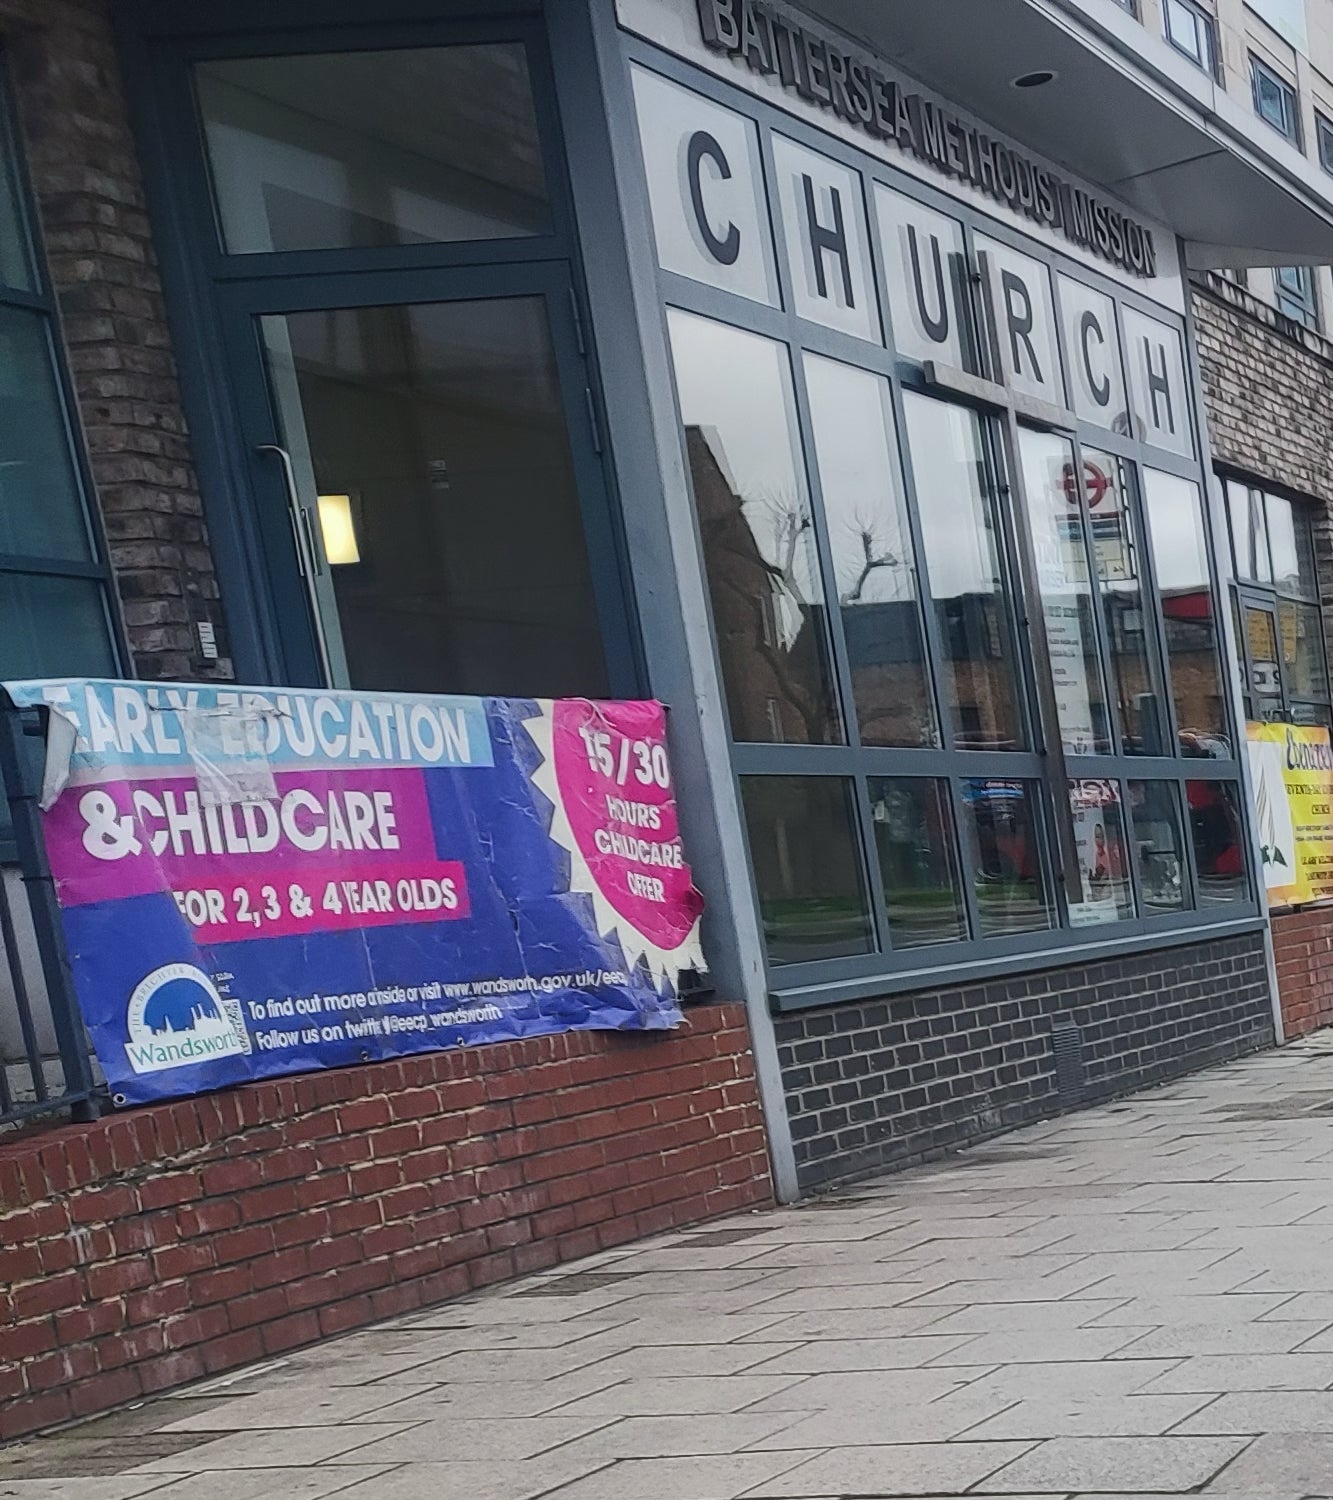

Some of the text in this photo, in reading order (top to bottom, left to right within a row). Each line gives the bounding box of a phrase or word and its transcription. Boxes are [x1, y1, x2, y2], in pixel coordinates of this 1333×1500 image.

[704, 0, 1157, 278] BATTERSEA METHODIST MISSION
[686, 131, 1175, 435] CHURCH
[216, 691, 472, 764] EDUCATION
[605, 793, 661, 831] HOURS
[594, 828, 684, 870] CHILDCARE
[172, 888, 228, 927] FOR
[289, 883, 313, 918] &
[396, 877, 459, 912] OLDS
[626, 870, 666, 903] OFFER
[248, 1000, 265, 1021] To
[266, 995, 293, 1018] find
[296, 994, 321, 1015] out
[323, 992, 366, 1012] more
[130, 1032, 239, 1066] Wandswort
[255, 1028, 300, 1050] Follow
[301, 1027, 320, 1045] us
[321, 1024, 344, 1043] on
